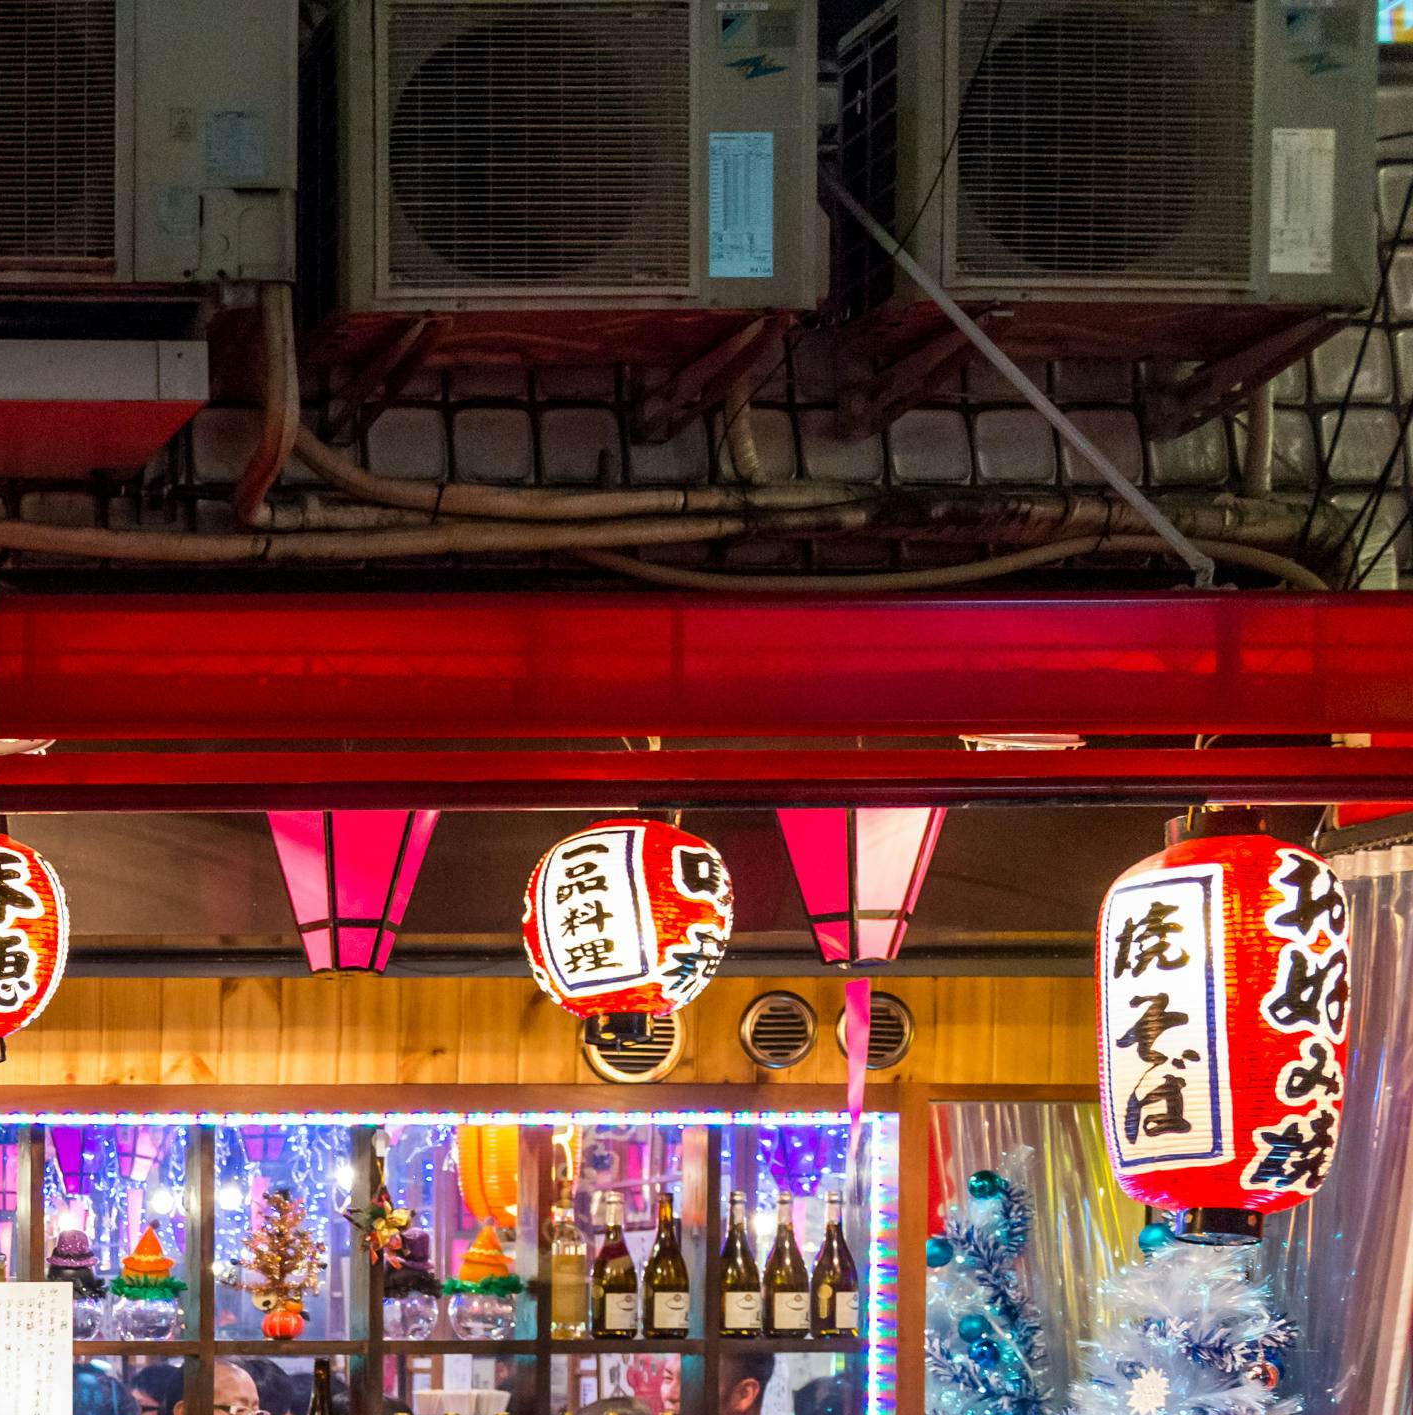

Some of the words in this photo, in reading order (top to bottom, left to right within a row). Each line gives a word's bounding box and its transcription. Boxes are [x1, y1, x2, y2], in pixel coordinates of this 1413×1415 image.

[556, 843, 623, 974] 一品料理
[1113, 901, 1201, 1145] 焼そば
[1249, 853, 1349, 1190] お好み焼
